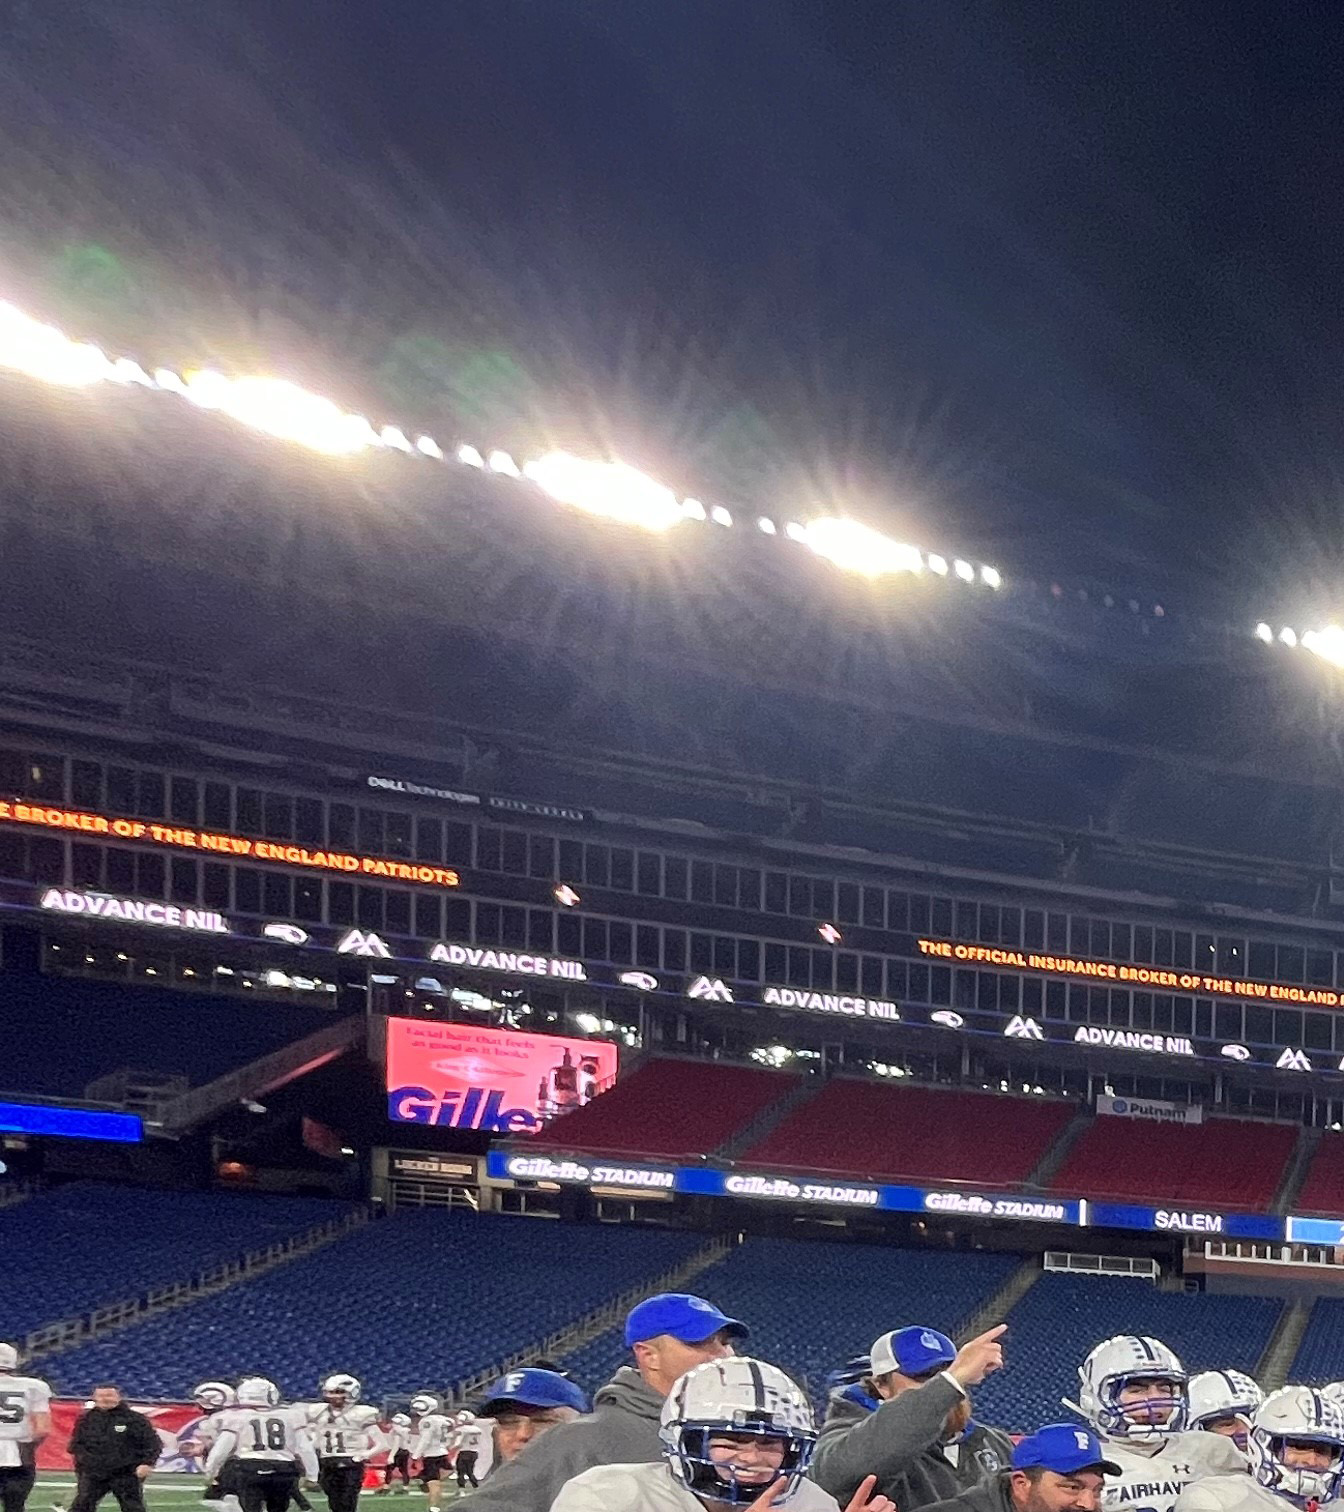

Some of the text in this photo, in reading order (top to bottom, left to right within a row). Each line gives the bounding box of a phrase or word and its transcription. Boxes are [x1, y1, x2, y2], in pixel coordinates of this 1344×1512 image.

[15, 806, 459, 886] BROKER OF THE NEW ENGLAND PATRIOTS
[42, 889, 231, 932] ADVANCE NIL
[431, 943, 587, 981] ADVANCE NIL
[918, 940, 951, 957] THE
[955, 945, 1026, 967] OFFICIAL
[1029, 955, 1116, 978] INSURANCE
[1119, 966, 1177, 985] BROKER
[1180, 975, 1200, 988] OF
[1203, 978, 1232, 993] THE
[1235, 983, 1268, 997] NEW
[1270, 986, 1337, 1005] ENGLAND
[764, 987, 900, 1020] ADVANCE NIL
[1074, 1026, 1193, 1055] ADVANCE NIL
[1130, 1102, 1187, 1119] Putnam
[508, 1157, 674, 1187] Gillette STADIUM
[725, 1176, 878, 1204] Gillette STADIUM
[925, 1193, 1064, 1219] Gillette STADIUM
[1155, 1210, 1222, 1232] SALEM
[505, 1373, 525, 1392] F
[250, 1418, 285, 1451] 18
[325, 1431, 345, 1453] 11
